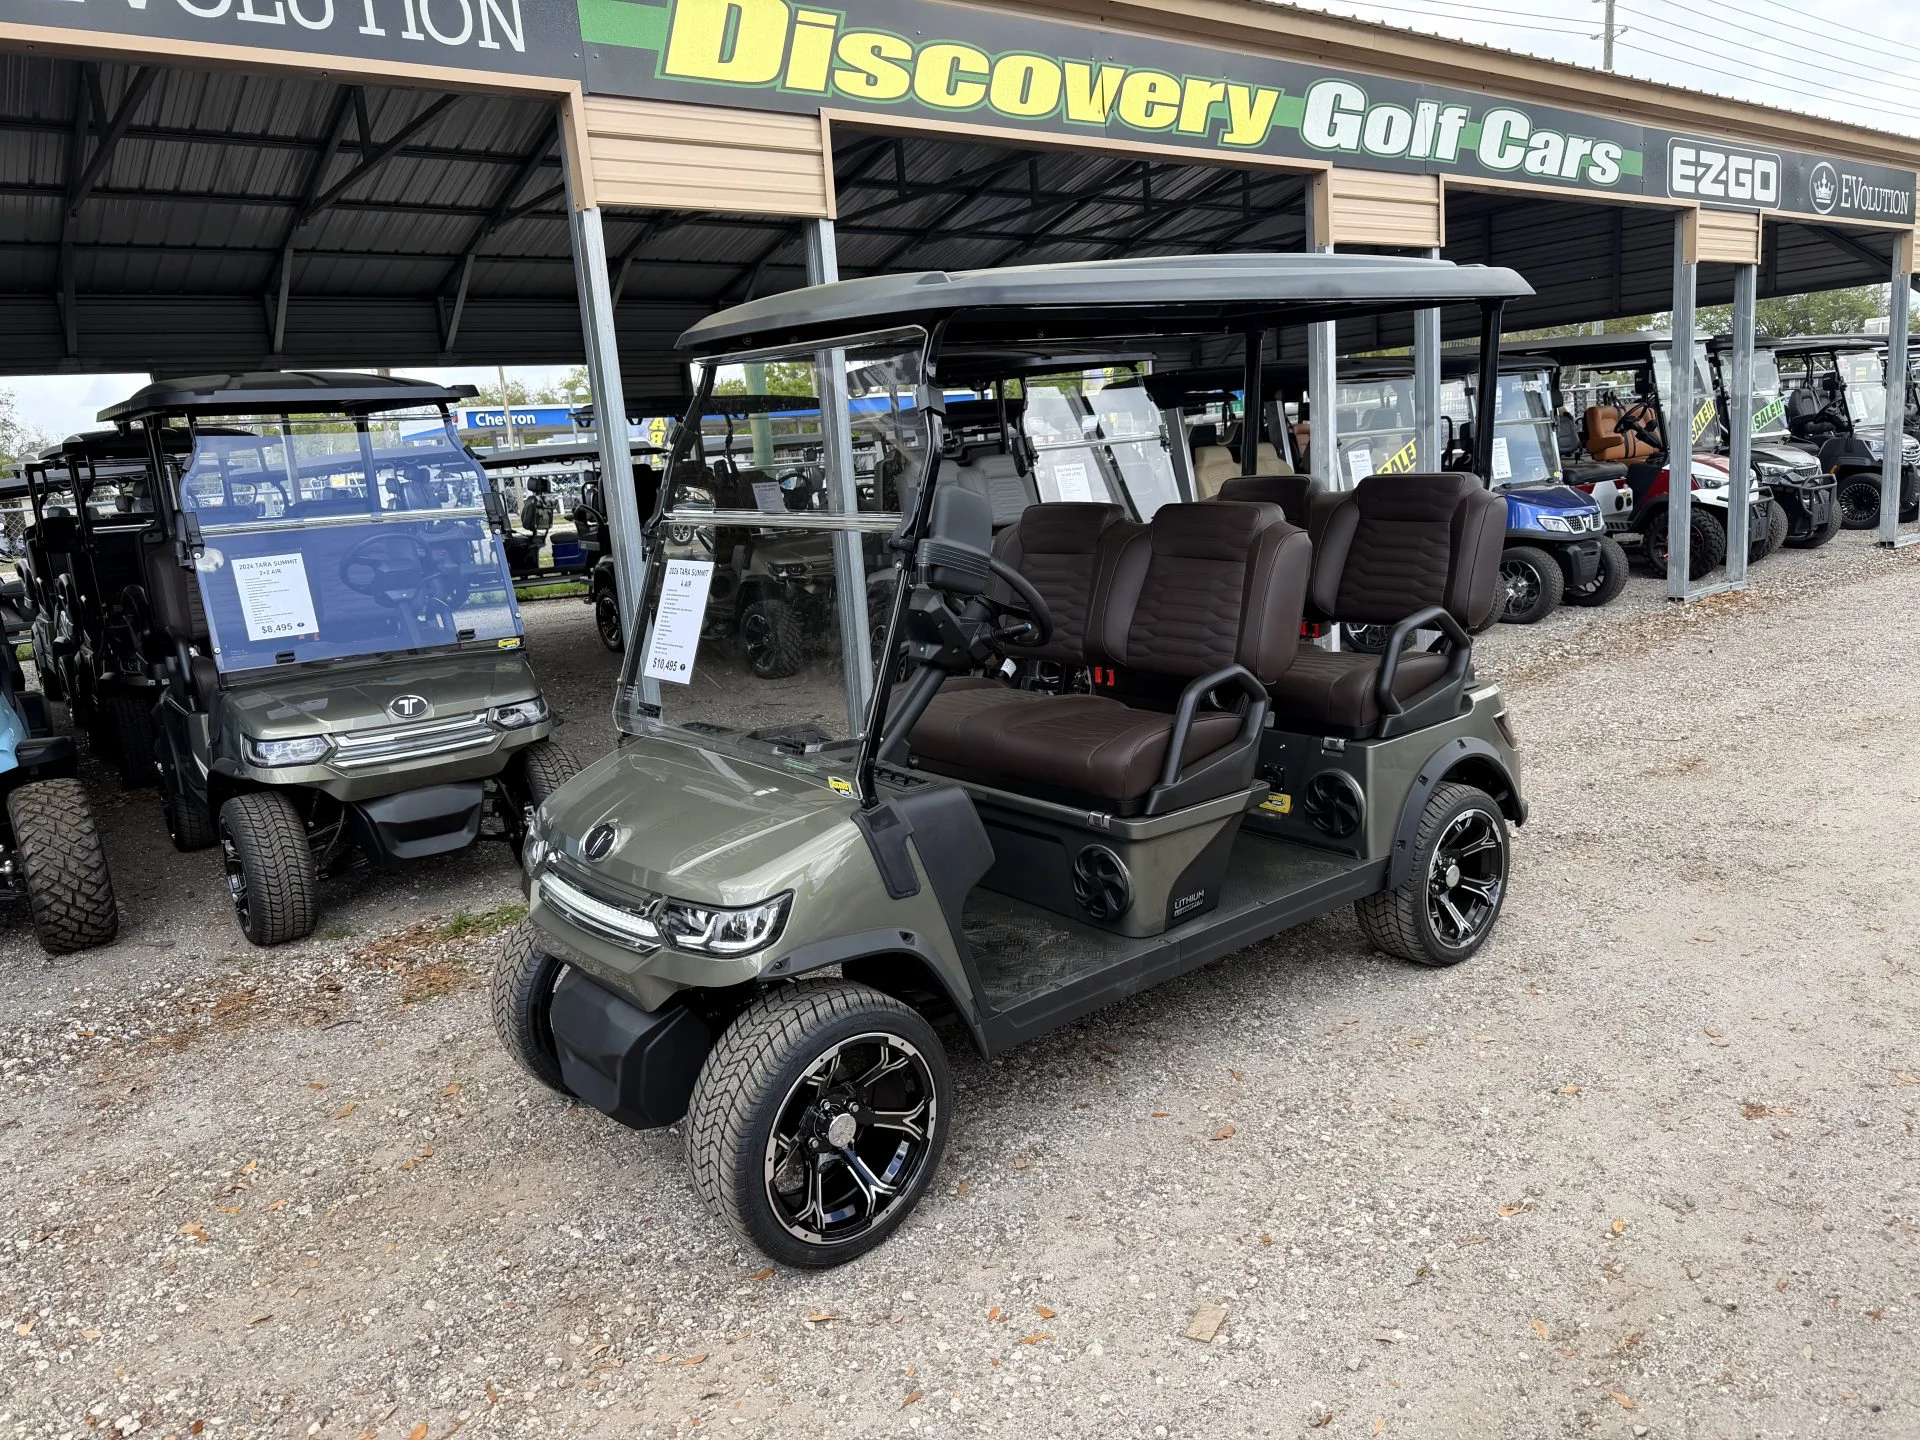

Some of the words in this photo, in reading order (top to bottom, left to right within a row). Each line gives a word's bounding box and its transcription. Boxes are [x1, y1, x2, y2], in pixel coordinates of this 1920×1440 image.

[665, 0, 1281, 146] Discovery
[1301, 81, 1468, 158] Golf
[1479, 105, 1622, 185] Cars
[255, 560, 272, 569] TARA
[273, 558, 298, 567] SUMMIT
[261, 622, 293, 634] $8,495
[652, 657, 678, 673] $10,495
[1174, 889, 1205, 910] LITHIUM
